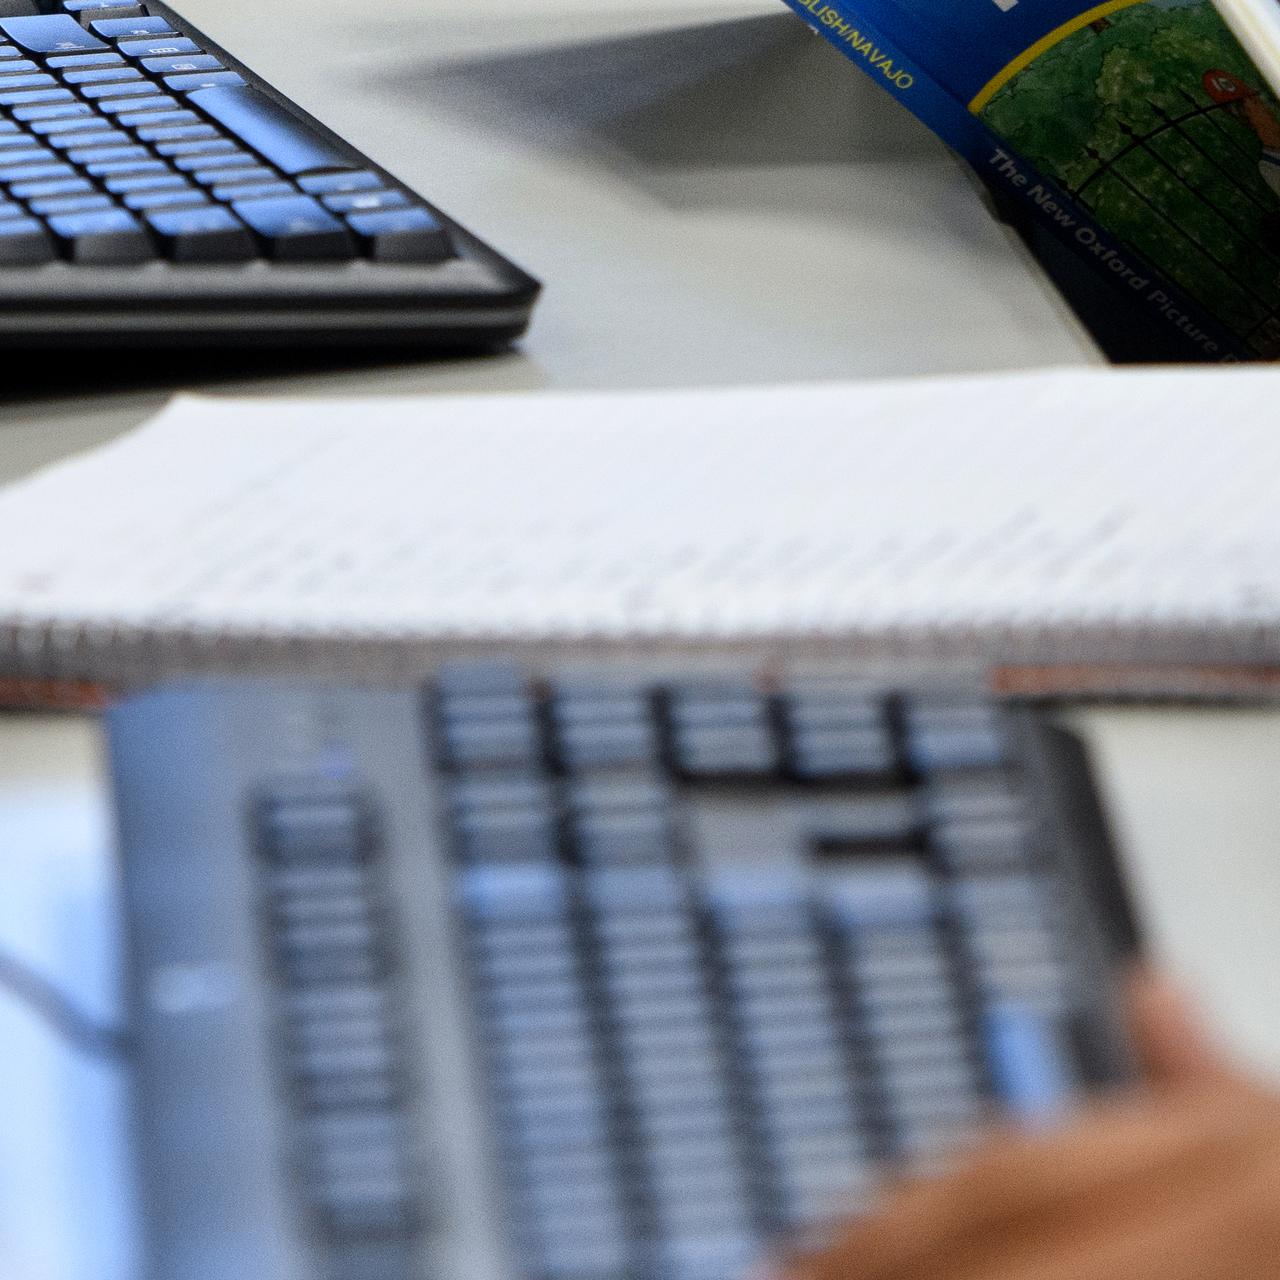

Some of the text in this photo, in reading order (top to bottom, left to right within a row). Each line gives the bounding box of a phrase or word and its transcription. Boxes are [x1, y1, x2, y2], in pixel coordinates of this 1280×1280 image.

[986, 147, 1219, 354] The New Oxford Picture
